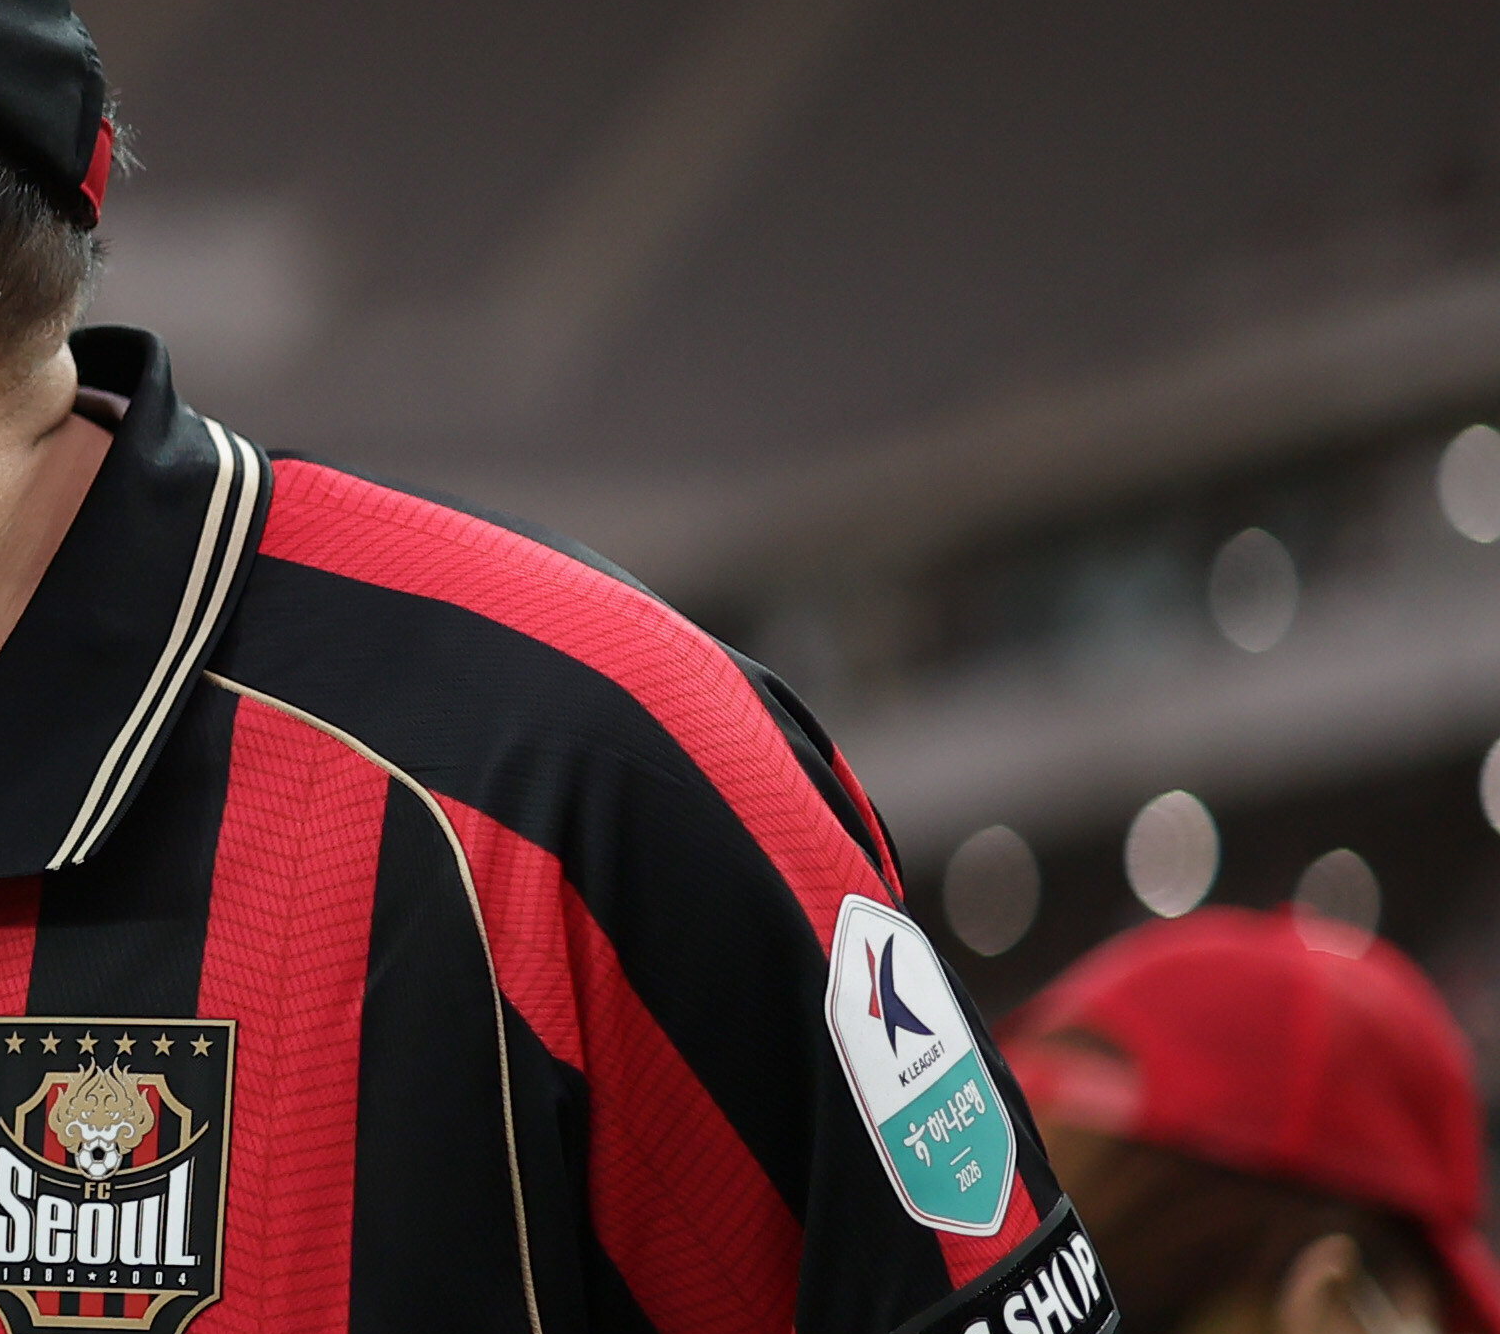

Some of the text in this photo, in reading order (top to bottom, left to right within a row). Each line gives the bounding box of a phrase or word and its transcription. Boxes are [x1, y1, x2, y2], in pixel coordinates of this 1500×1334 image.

[898, 1040, 945, 1088] K LEAGUE 1
[926, 1078, 986, 1144] 하나은행
[84, 1181, 111, 1201] FC
[955, 1159, 982, 1193] 2026
[2, 1267, 187, 1286] 1983 2004
